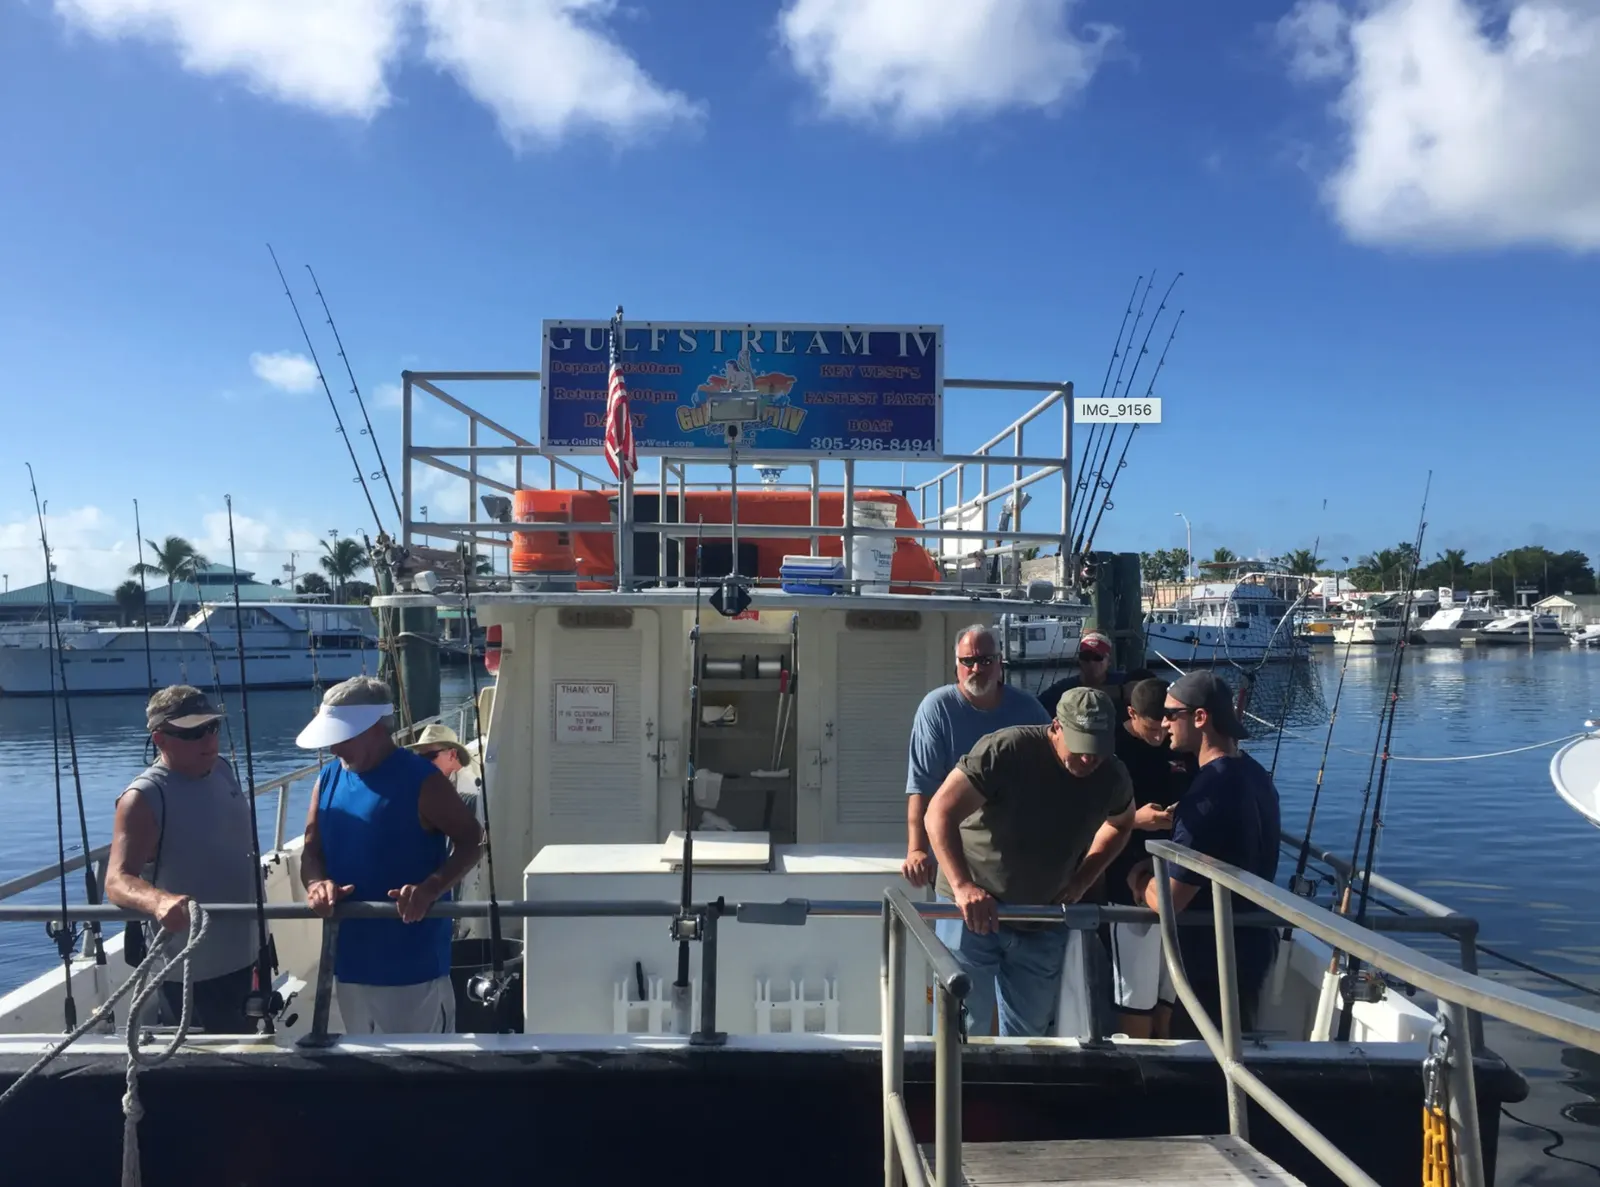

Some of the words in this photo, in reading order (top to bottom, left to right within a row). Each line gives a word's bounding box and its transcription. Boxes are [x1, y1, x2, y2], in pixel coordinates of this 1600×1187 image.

[549, 328, 872, 355] GULFSTREAM
[898, 331, 932, 357] IV
[552, 361, 607, 375] Depart
[620, 361, 682, 375] 0:00am
[820, 364, 855, 378] KEY
[859, 365, 921, 379] WEST'S
[554, 387, 609, 400] Return
[628, 389, 678, 403] :00pm
[804, 391, 878, 405] FASTEST
[883, 392, 935, 406] PARTY
[848, 419, 893, 432] BOAT
[810, 437, 934, 451] 305-296-8494
[561, 685, 590, 693] THANK
[592, 685, 610, 694] YOU
